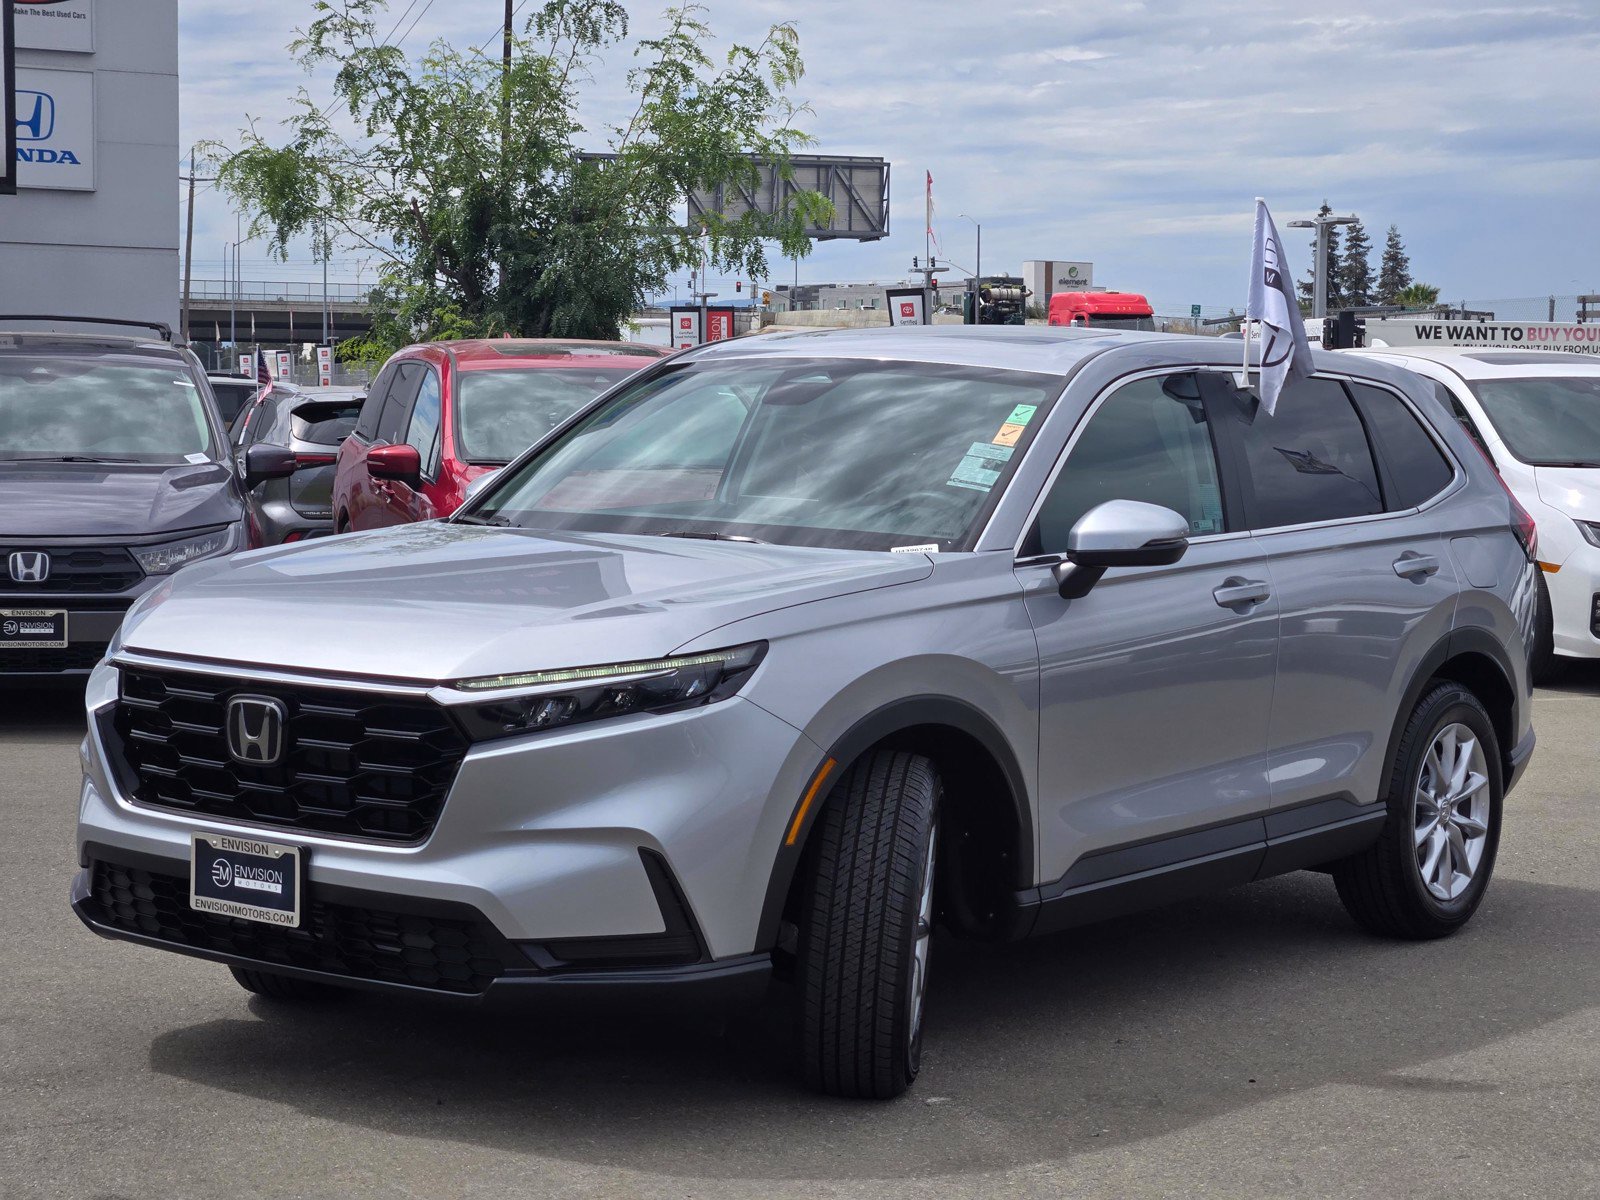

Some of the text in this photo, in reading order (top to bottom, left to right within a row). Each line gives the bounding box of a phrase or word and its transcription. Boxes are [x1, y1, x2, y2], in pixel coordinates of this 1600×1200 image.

[1058, 277, 1088, 286] element
[1415, 325, 1600, 341] WE WANT TO BUY YOU
[1564, 345, 1590, 354] FROM
[1592, 345, 1600, 354] U
[20, 621, 54, 629] ENVISION
[221, 838, 269, 855] ENVISION
[234, 865, 283, 884] ENVISION
[195, 899, 294, 925] ENVISIONMOTORS.COM
